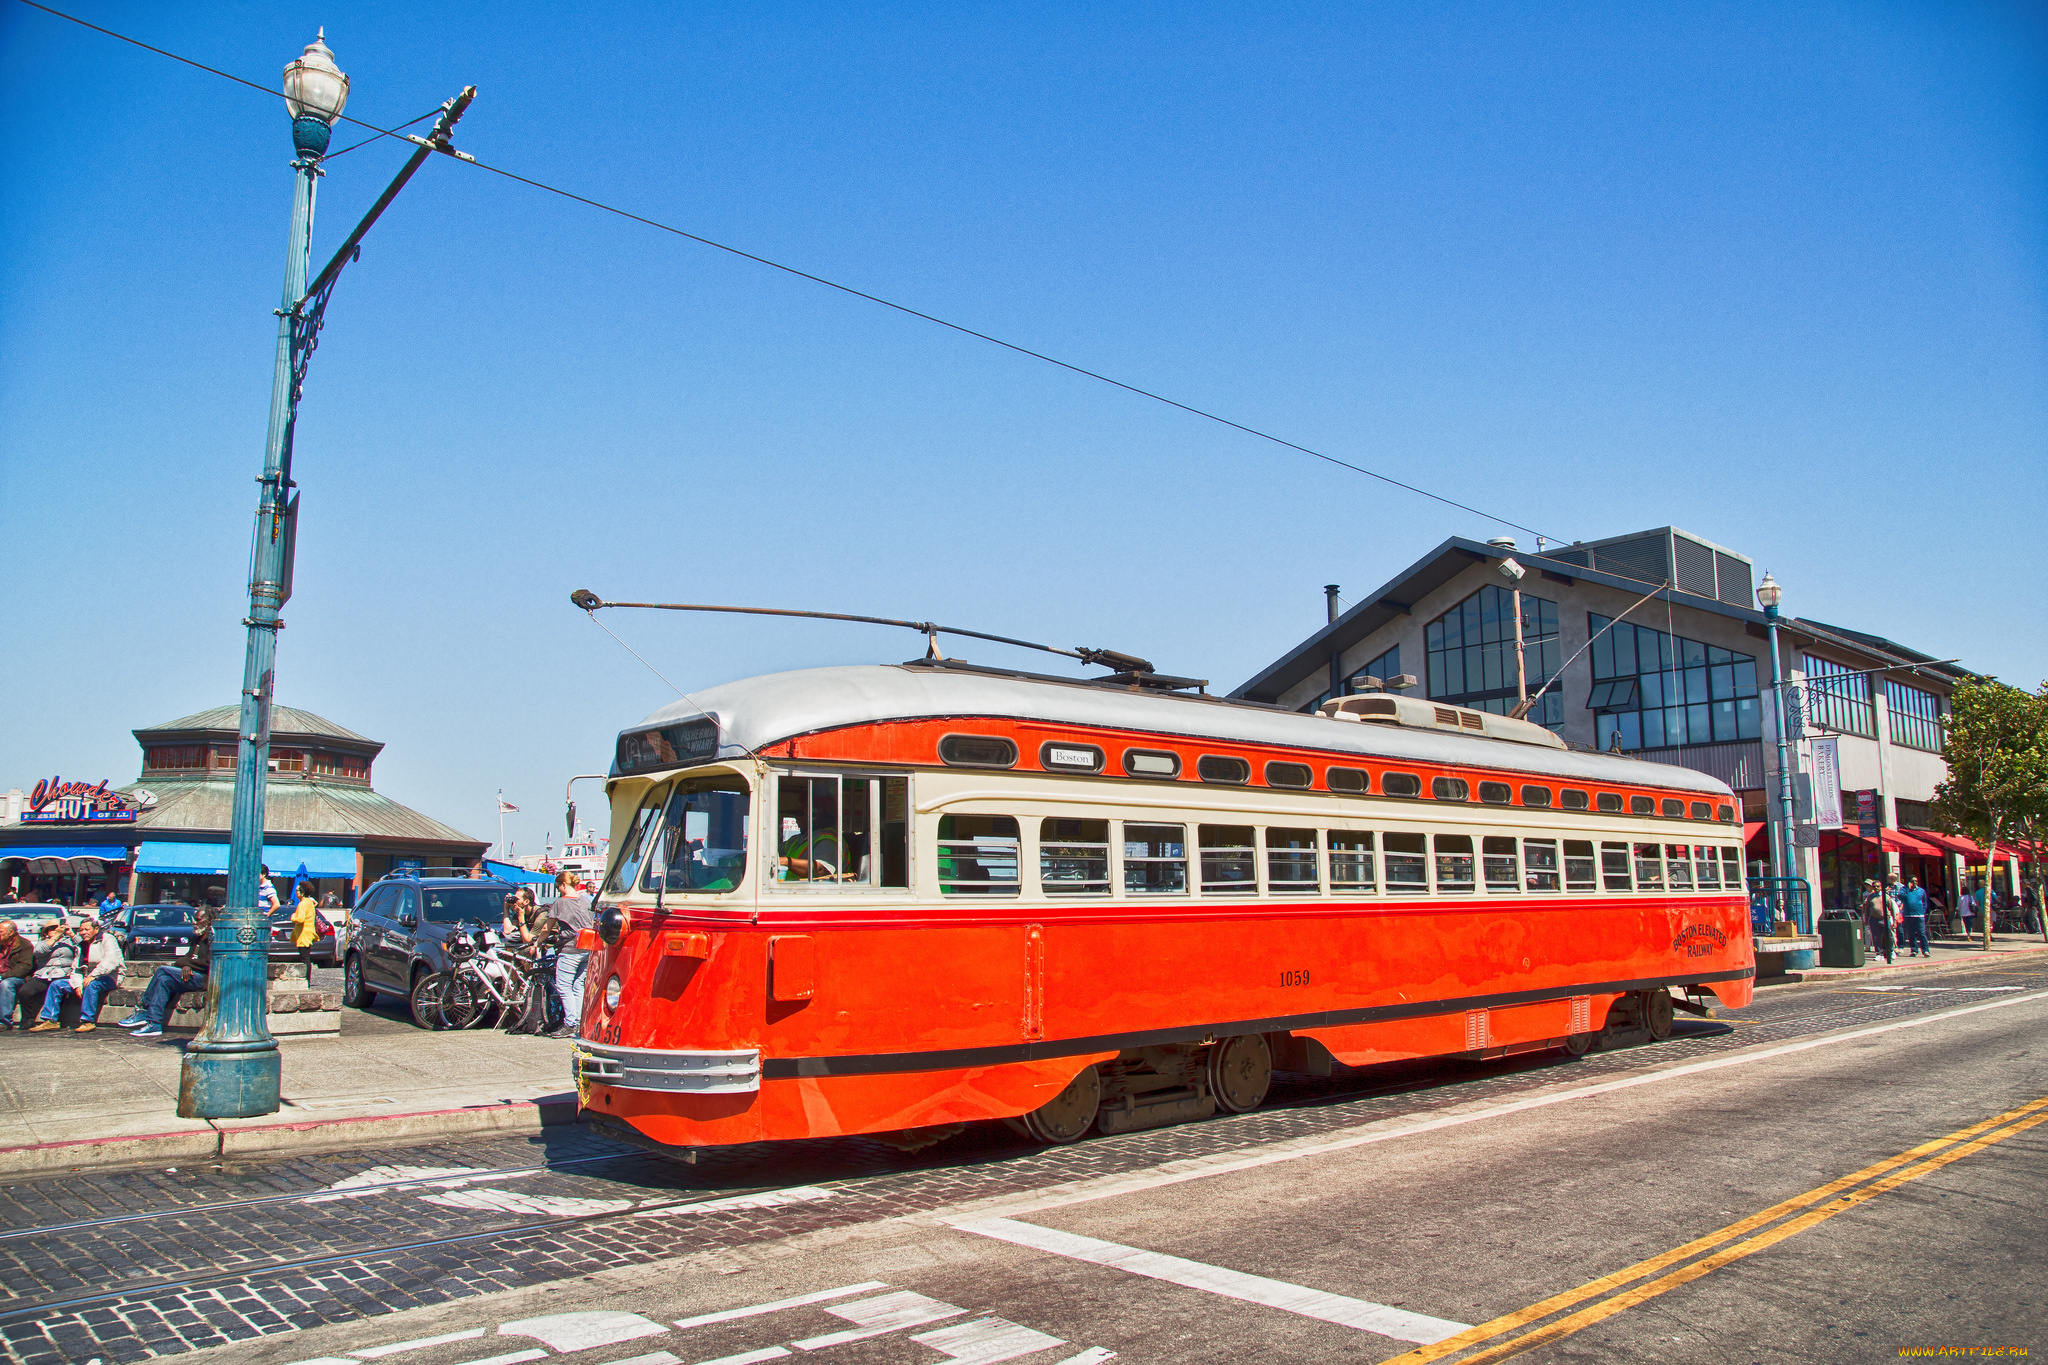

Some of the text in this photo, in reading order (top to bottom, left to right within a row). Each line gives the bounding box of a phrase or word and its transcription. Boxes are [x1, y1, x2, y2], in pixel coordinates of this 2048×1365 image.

[1056, 751, 1089, 763] Boston
[30, 776, 122, 810] Chowder
[55, 799, 94, 819] HUT
[97, 812, 129, 820] GRILL
[1673, 924, 1727, 952] BOSTON ELEVATED
[1687, 943, 1714, 957] RAILWAY
[1279, 969, 1310, 988] 1059
[590, 1022, 621, 1045] 1059
